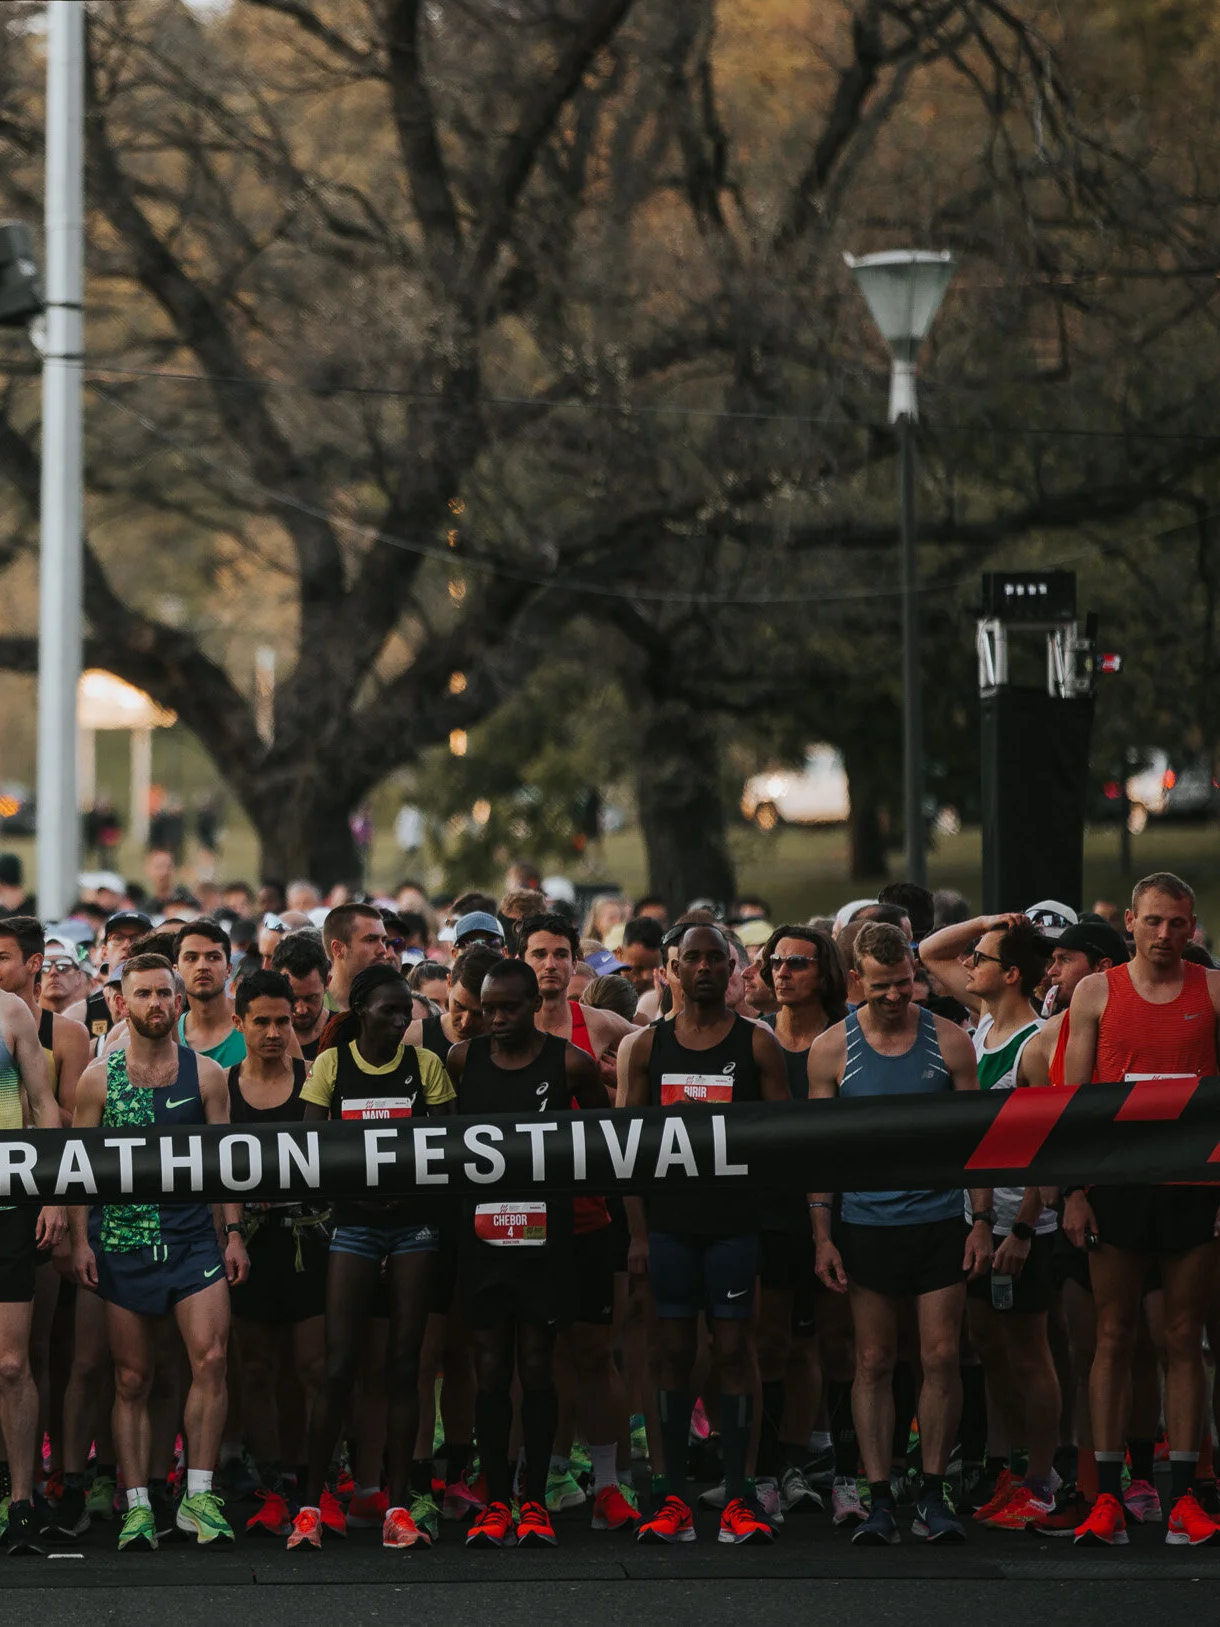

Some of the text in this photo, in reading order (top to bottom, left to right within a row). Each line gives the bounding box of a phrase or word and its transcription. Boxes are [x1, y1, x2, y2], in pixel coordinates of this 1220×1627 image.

[363, 1115, 750, 1187] FESTIVAL
[493, 1214, 528, 1226] CHEBOR
[507, 1226, 514, 1238] 4
